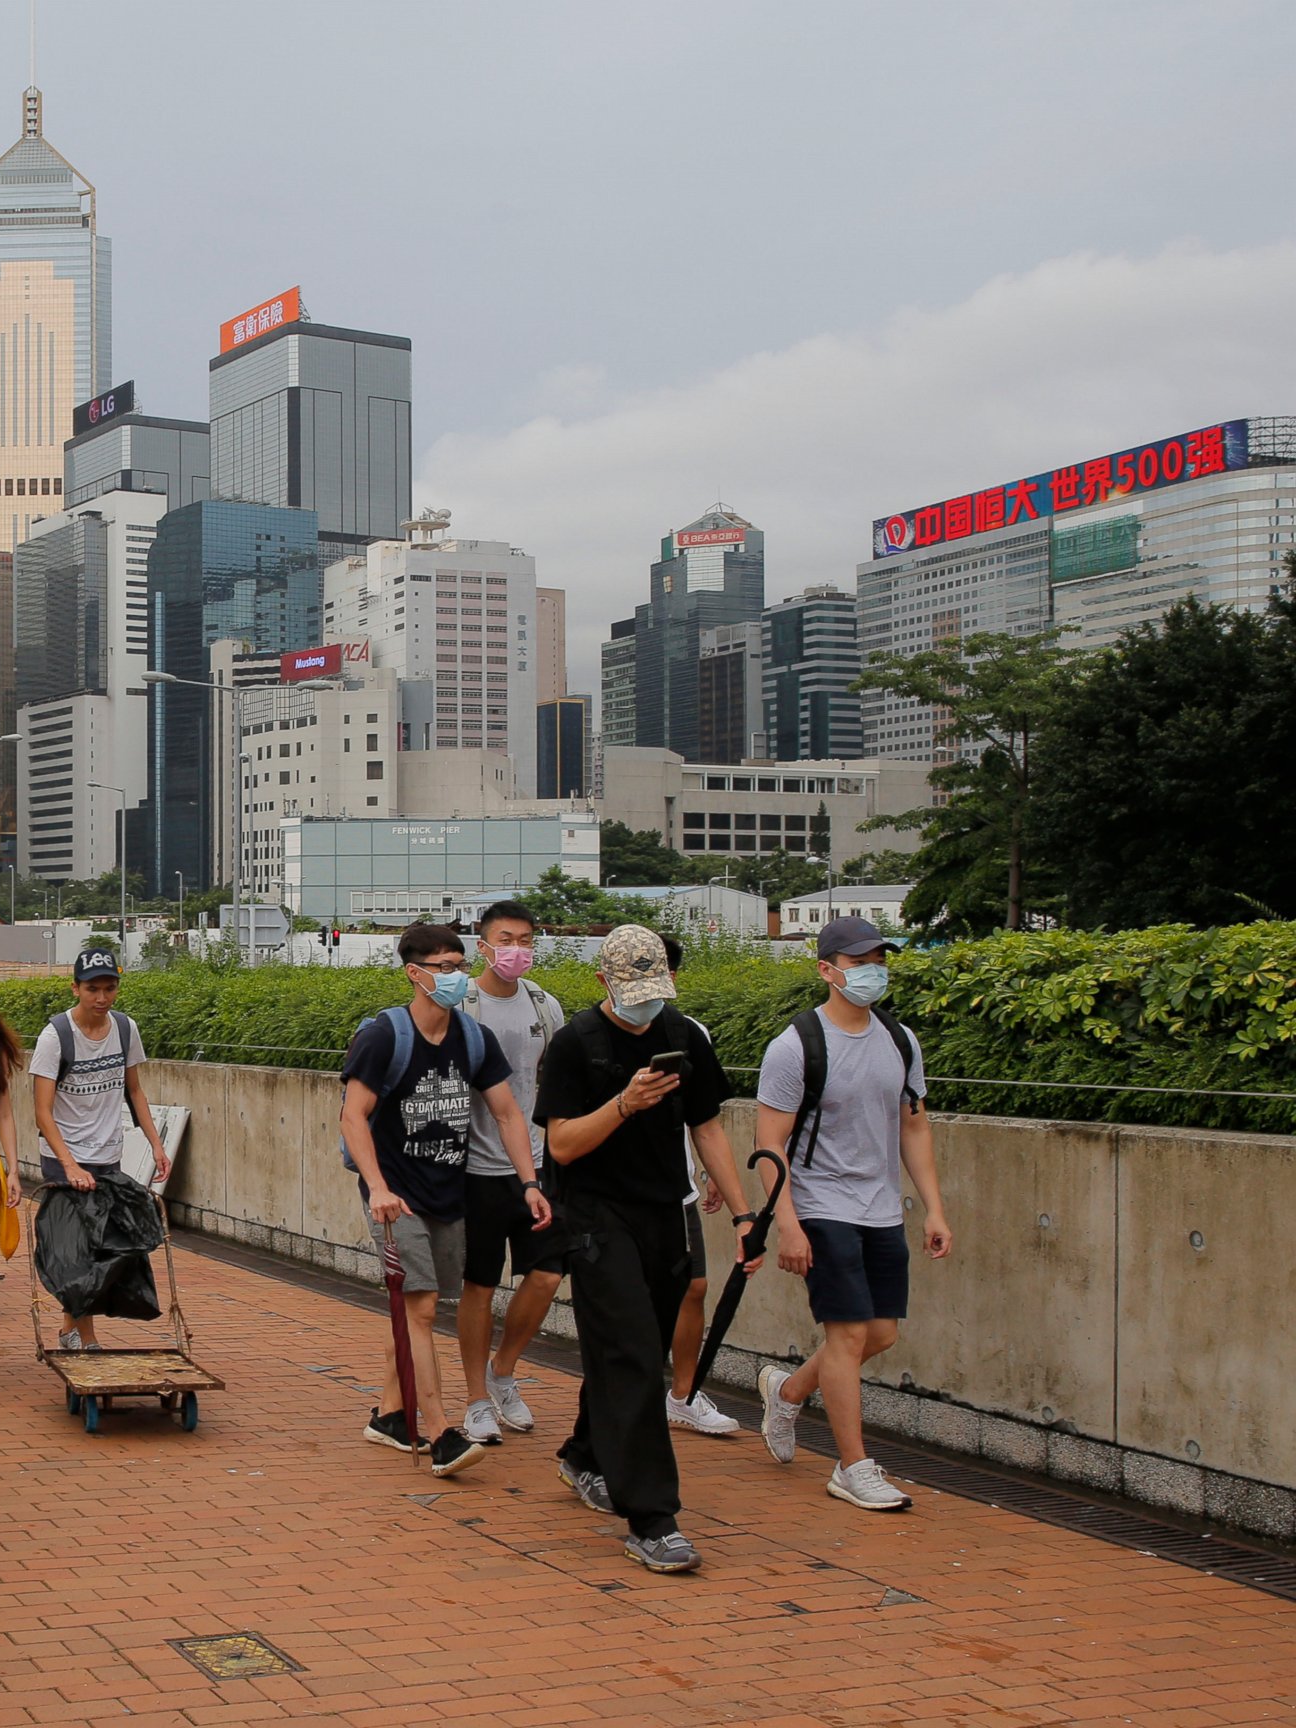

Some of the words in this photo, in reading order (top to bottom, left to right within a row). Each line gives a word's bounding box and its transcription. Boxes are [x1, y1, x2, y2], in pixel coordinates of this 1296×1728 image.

[233, 300, 284, 345] 富衛保險
[101, 395, 115, 417] LG
[914, 479, 1039, 546] 中国恒大
[1049, 426, 1227, 512] 世界500强
[690, 534, 711, 543] BEA
[295, 656, 325, 669] Mustang
[391, 826, 432, 835] FENWICK
[440, 826, 461, 834] PIER
[81, 952, 114, 970] Lee
[442, 1080, 459, 1088] DOWN
[405, 1100, 435, 1114] G'DAY
[438, 1097, 470, 1110] MATE
